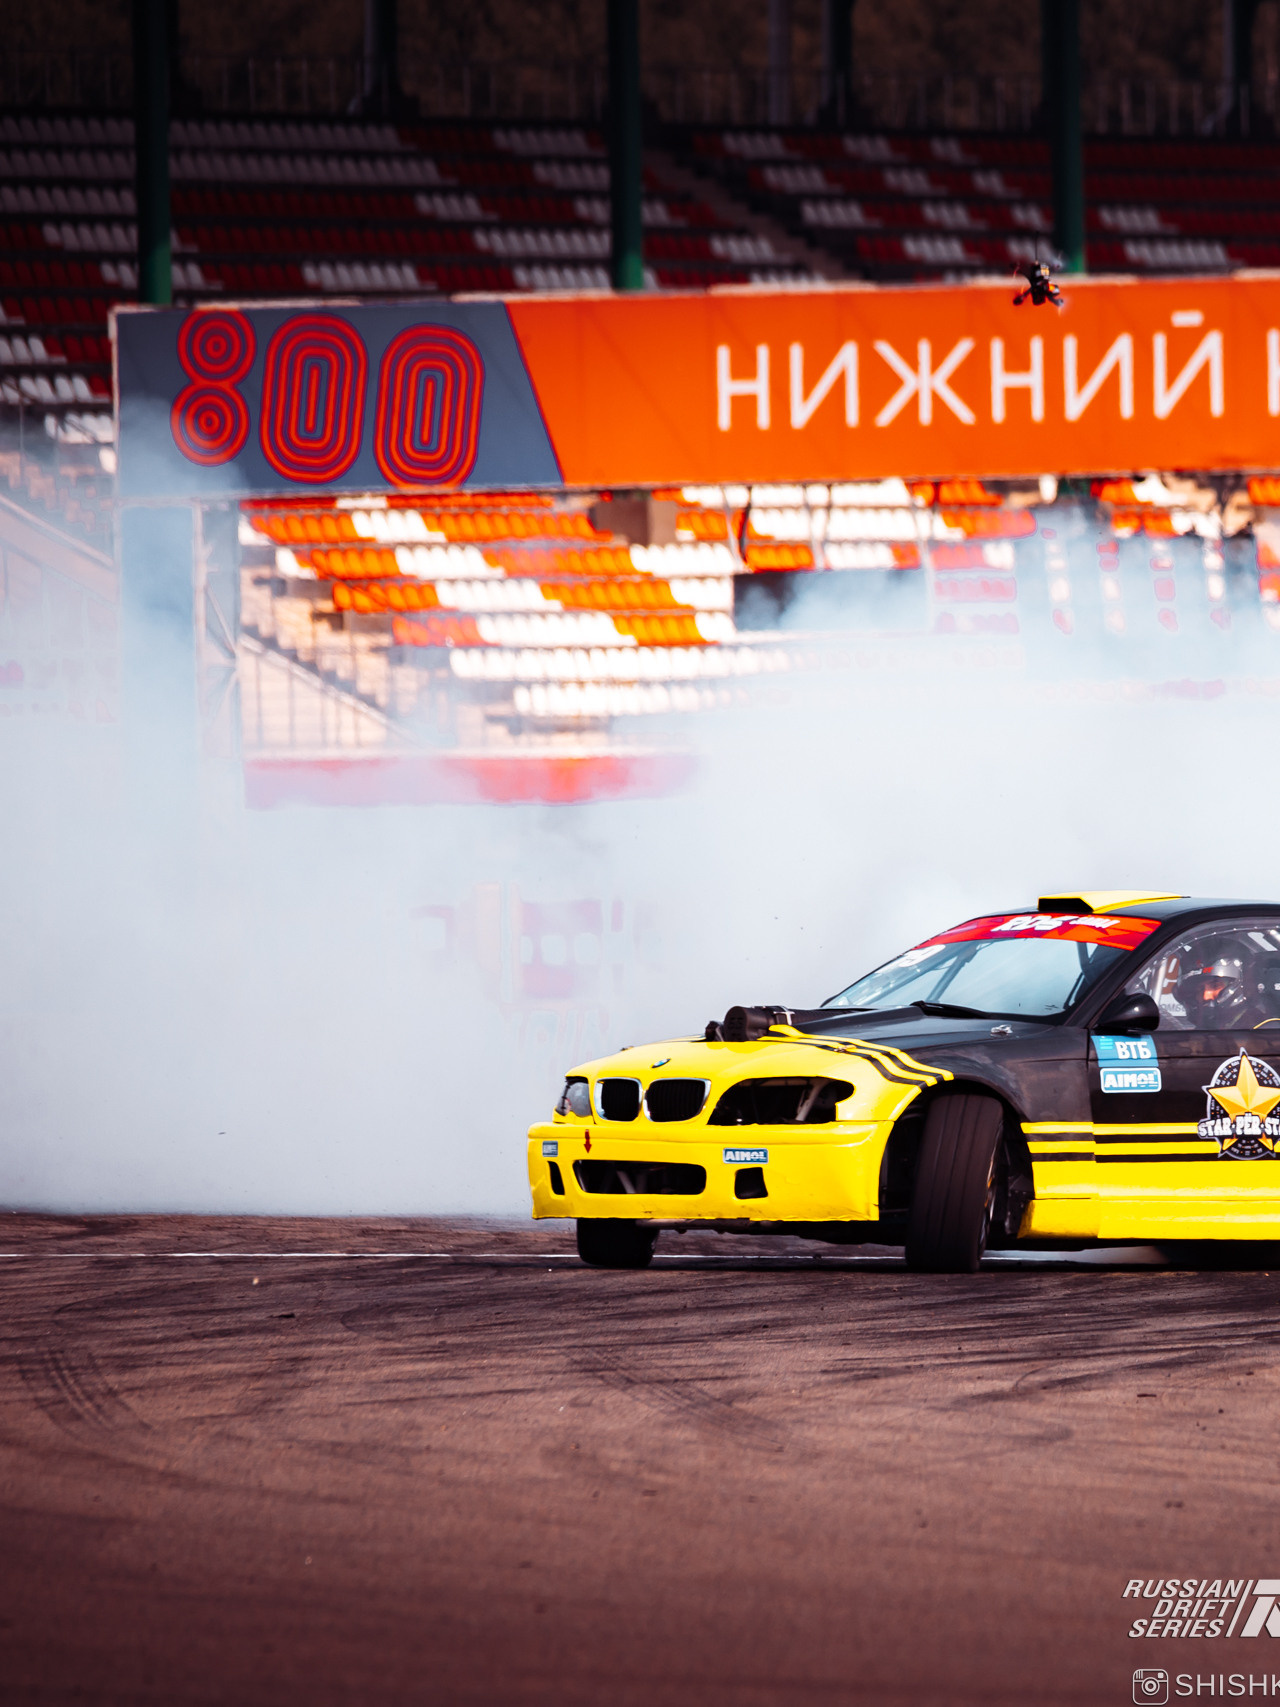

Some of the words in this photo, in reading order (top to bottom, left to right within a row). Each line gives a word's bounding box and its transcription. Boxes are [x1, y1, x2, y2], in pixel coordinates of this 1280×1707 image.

[716, 310, 1225, 431] НИЖНИЙ
[170, 308, 485, 490] 800
[1115, 1041, 1152, 1060] ВТБ
[1104, 1072, 1158, 1088] AIMOL
[724, 1150, 768, 1162] AIMOL
